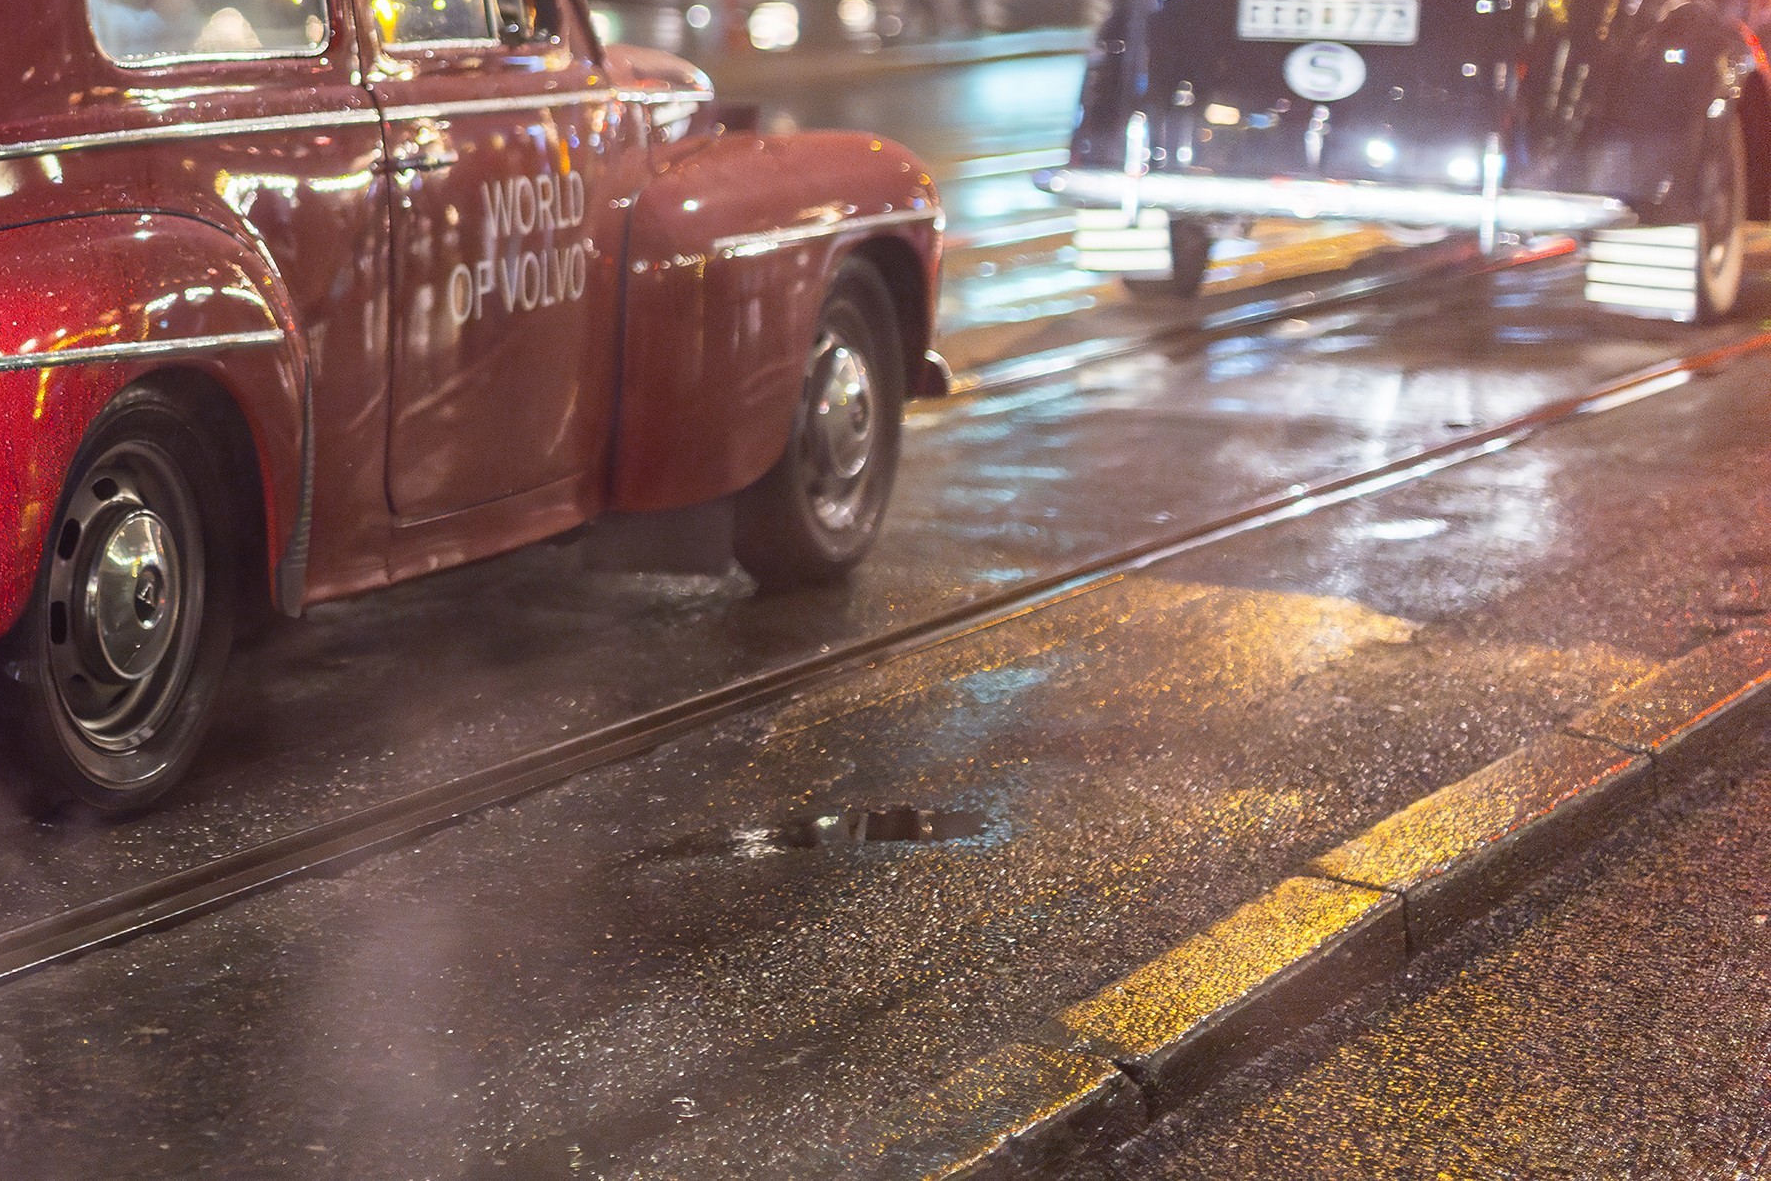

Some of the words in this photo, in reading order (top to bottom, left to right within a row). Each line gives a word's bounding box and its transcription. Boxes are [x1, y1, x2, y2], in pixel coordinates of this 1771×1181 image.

[483, 170, 584, 238] WORLD
[450, 261, 495, 325] OF
[500, 242, 586, 314] VOLVO
